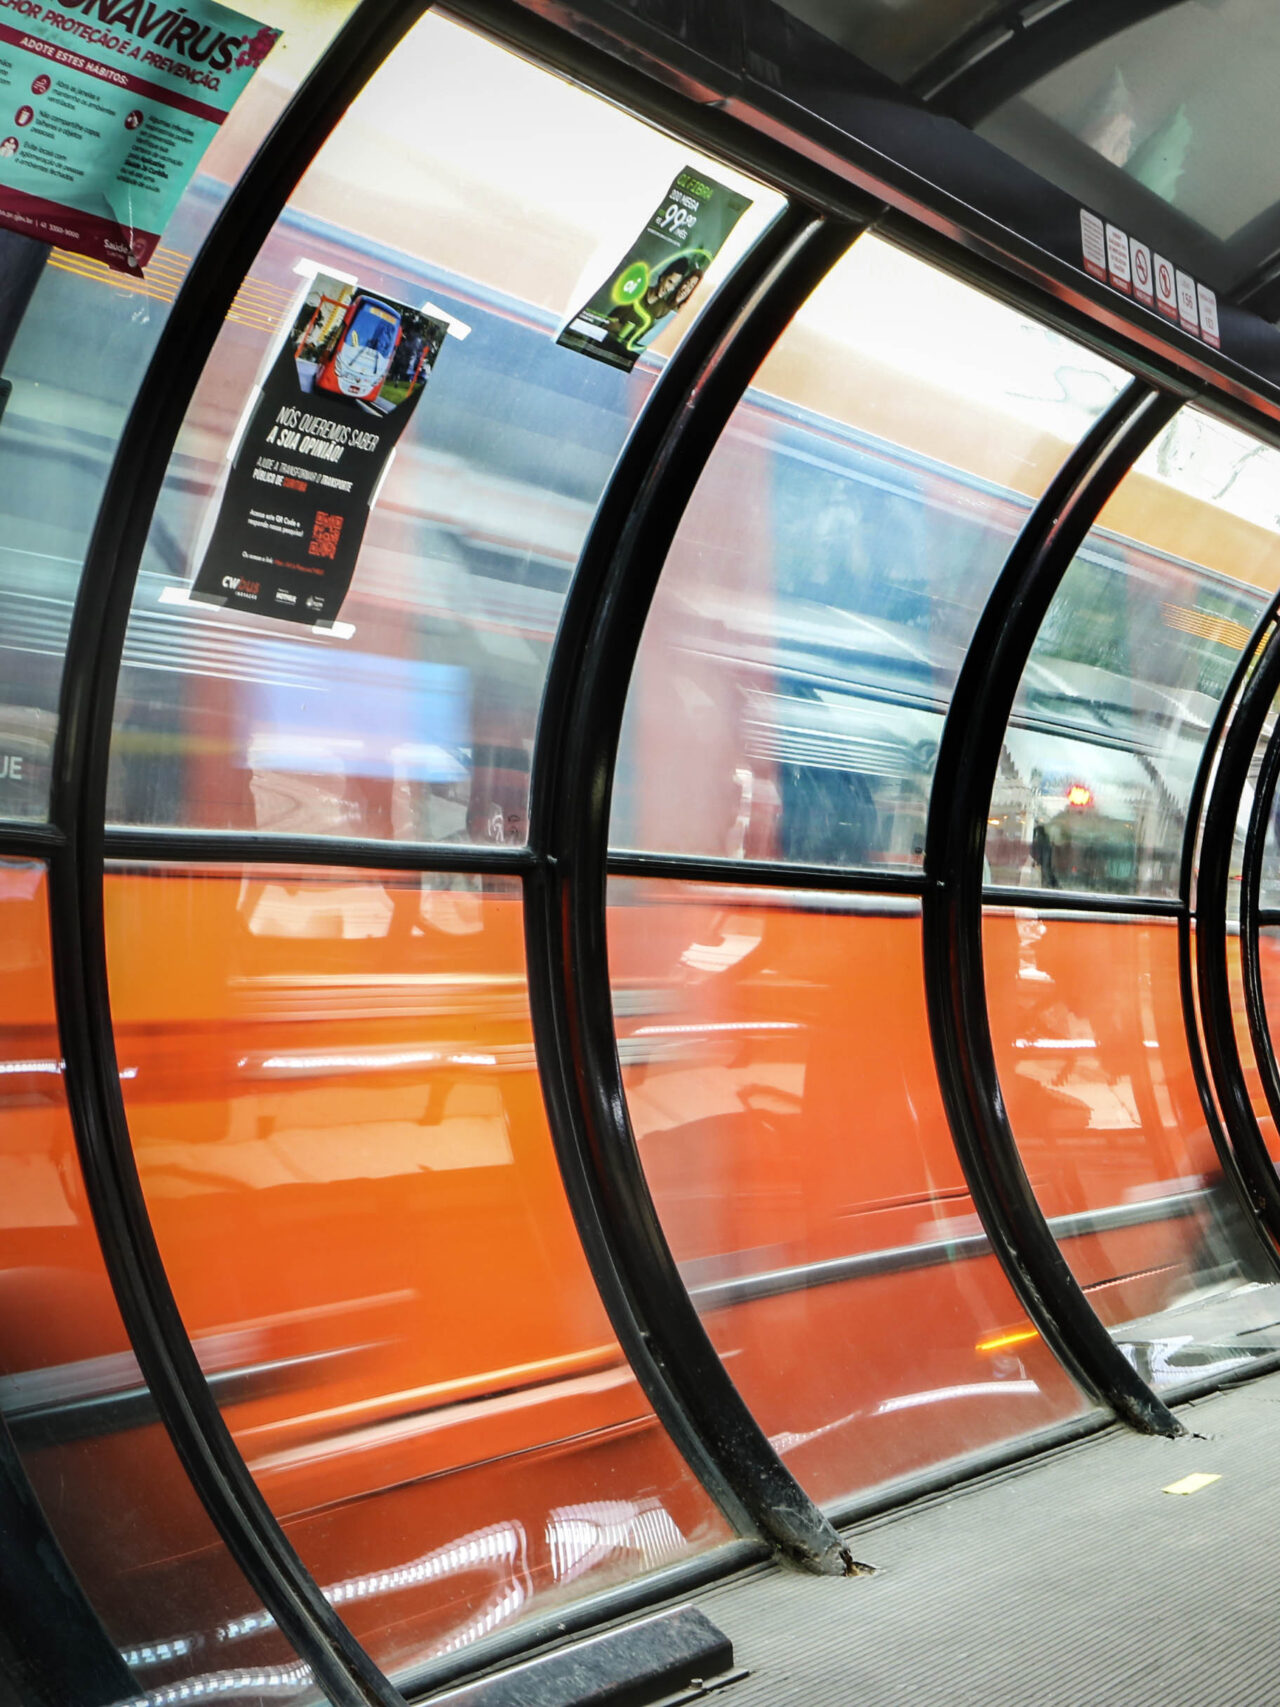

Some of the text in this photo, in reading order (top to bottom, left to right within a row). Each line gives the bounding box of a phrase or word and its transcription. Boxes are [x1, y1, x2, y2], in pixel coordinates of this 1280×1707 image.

[20, 37, 55, 56] ADOTE
[55, 50, 85, 68] ESTES
[41, 9, 120, 49] PROTEÇÃO
[127, 46, 141, 60] A
[57, 0, 242, 70] NAVÍRUS
[623, 277, 642, 294] oi
[266, 426, 344, 463] A SUA OPINIÃO!
[276, 406, 379, 452] NÓS QUEREMOS SABER
